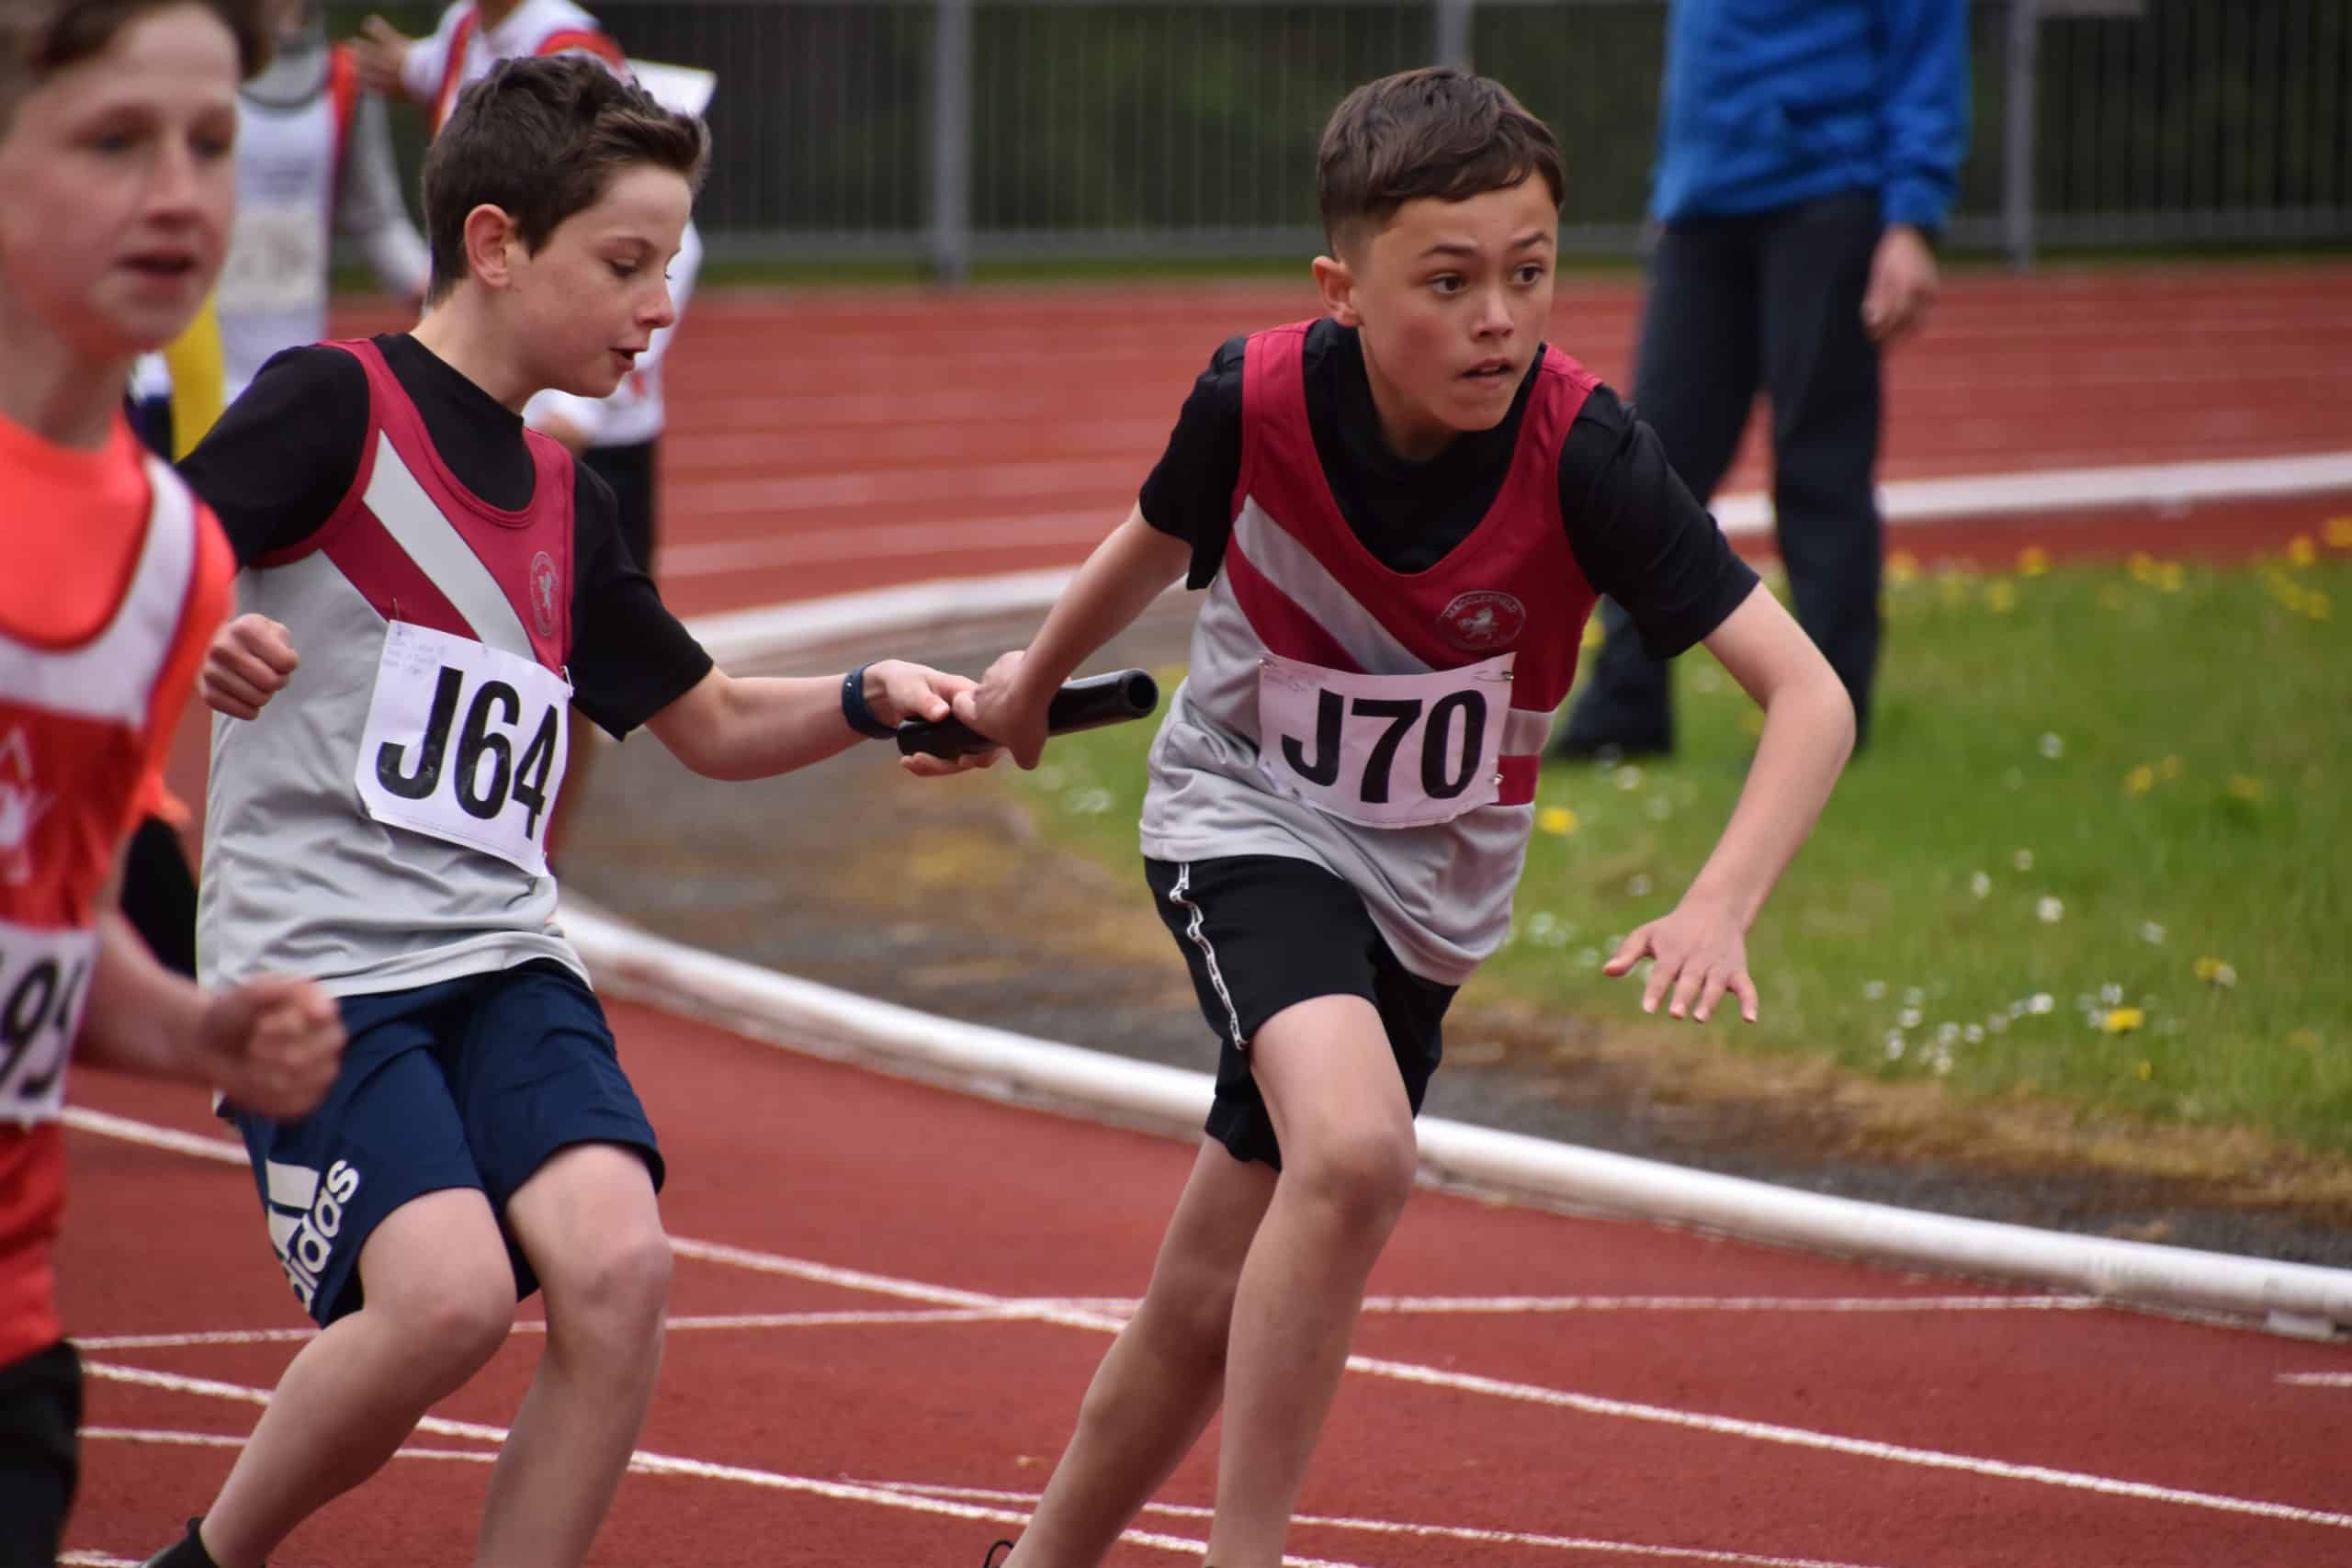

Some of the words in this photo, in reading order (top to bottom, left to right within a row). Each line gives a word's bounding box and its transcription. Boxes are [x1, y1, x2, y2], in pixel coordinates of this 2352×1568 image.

[376, 665, 559, 841] J64
[1281, 687, 1487, 805] J70
[281, 1159, 360, 1315] didas
